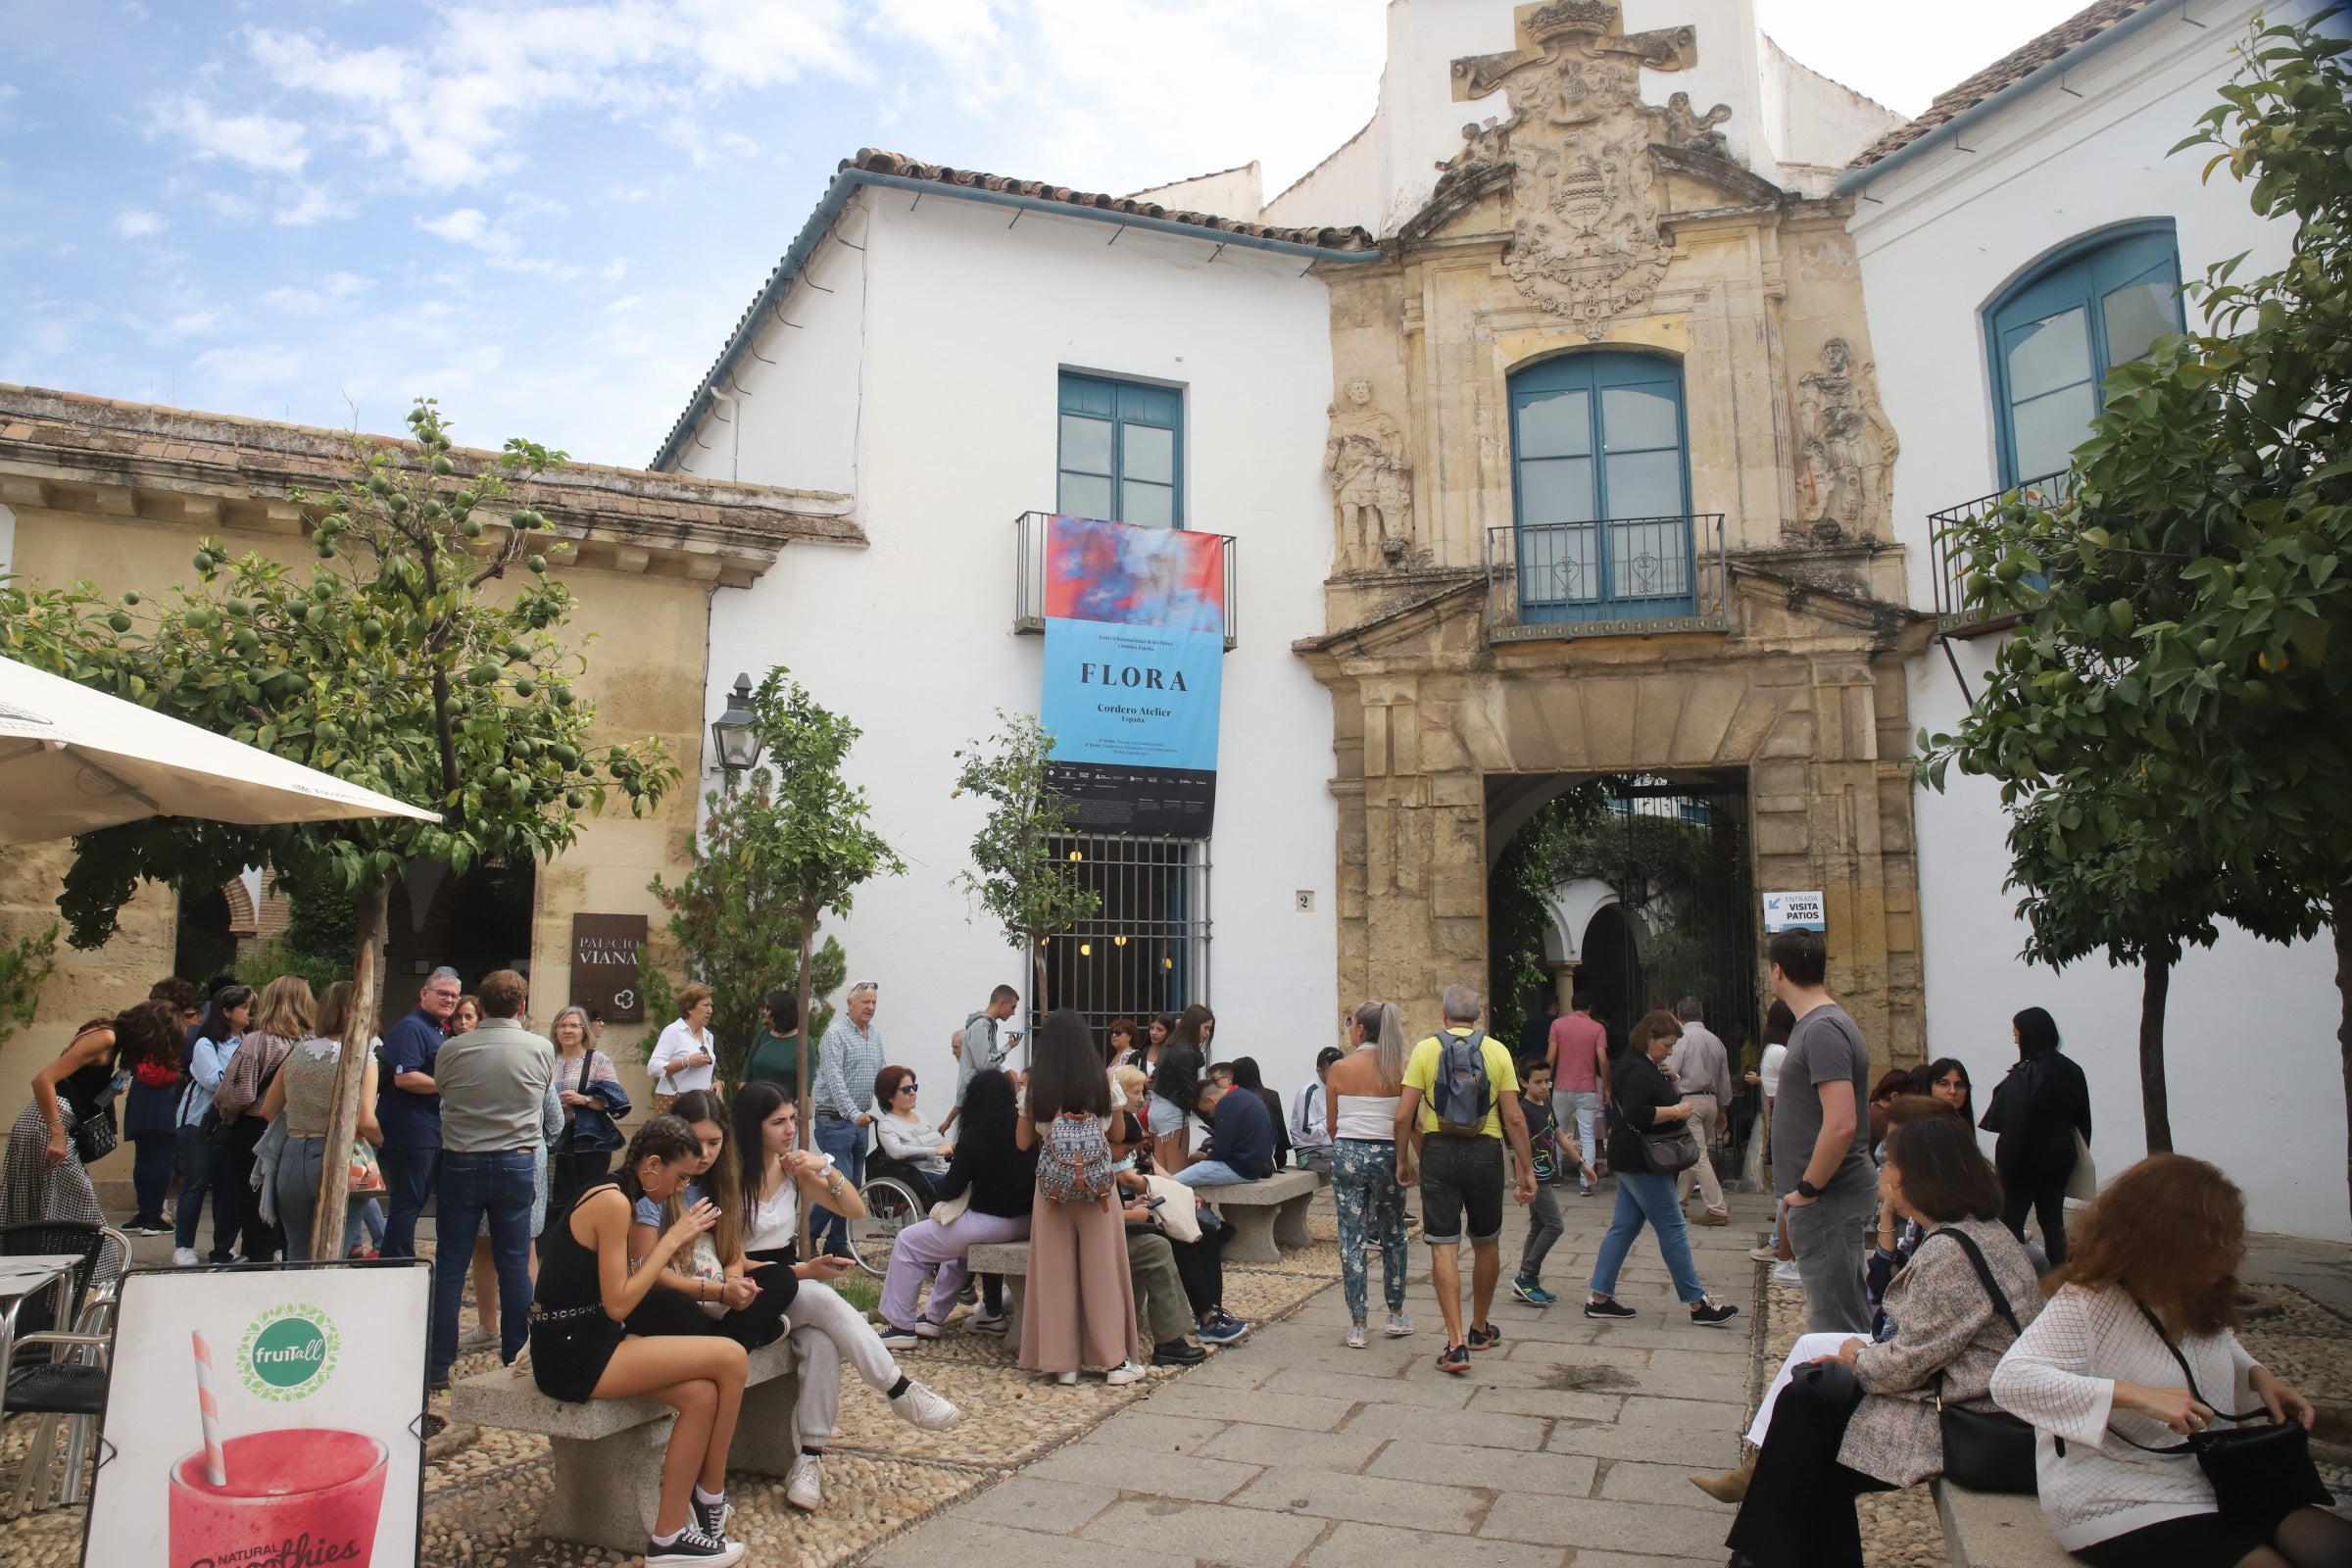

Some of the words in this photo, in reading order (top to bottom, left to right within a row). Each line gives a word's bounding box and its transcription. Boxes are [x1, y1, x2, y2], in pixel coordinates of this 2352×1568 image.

[1080, 662, 1188, 692] FLORA
[1098, 703, 1137, 715] Cordero
[1139, 706, 1172, 717] Atelier
[1299, 895, 1308, 908] 2
[1789, 903, 1819, 911] VISITA
[1787, 911, 1820, 920] PATIOS
[580, 951, 638, 965] VIANA
[189, 1533, 361, 1568] thies
[218, 1544, 280, 1566] NATURAL
